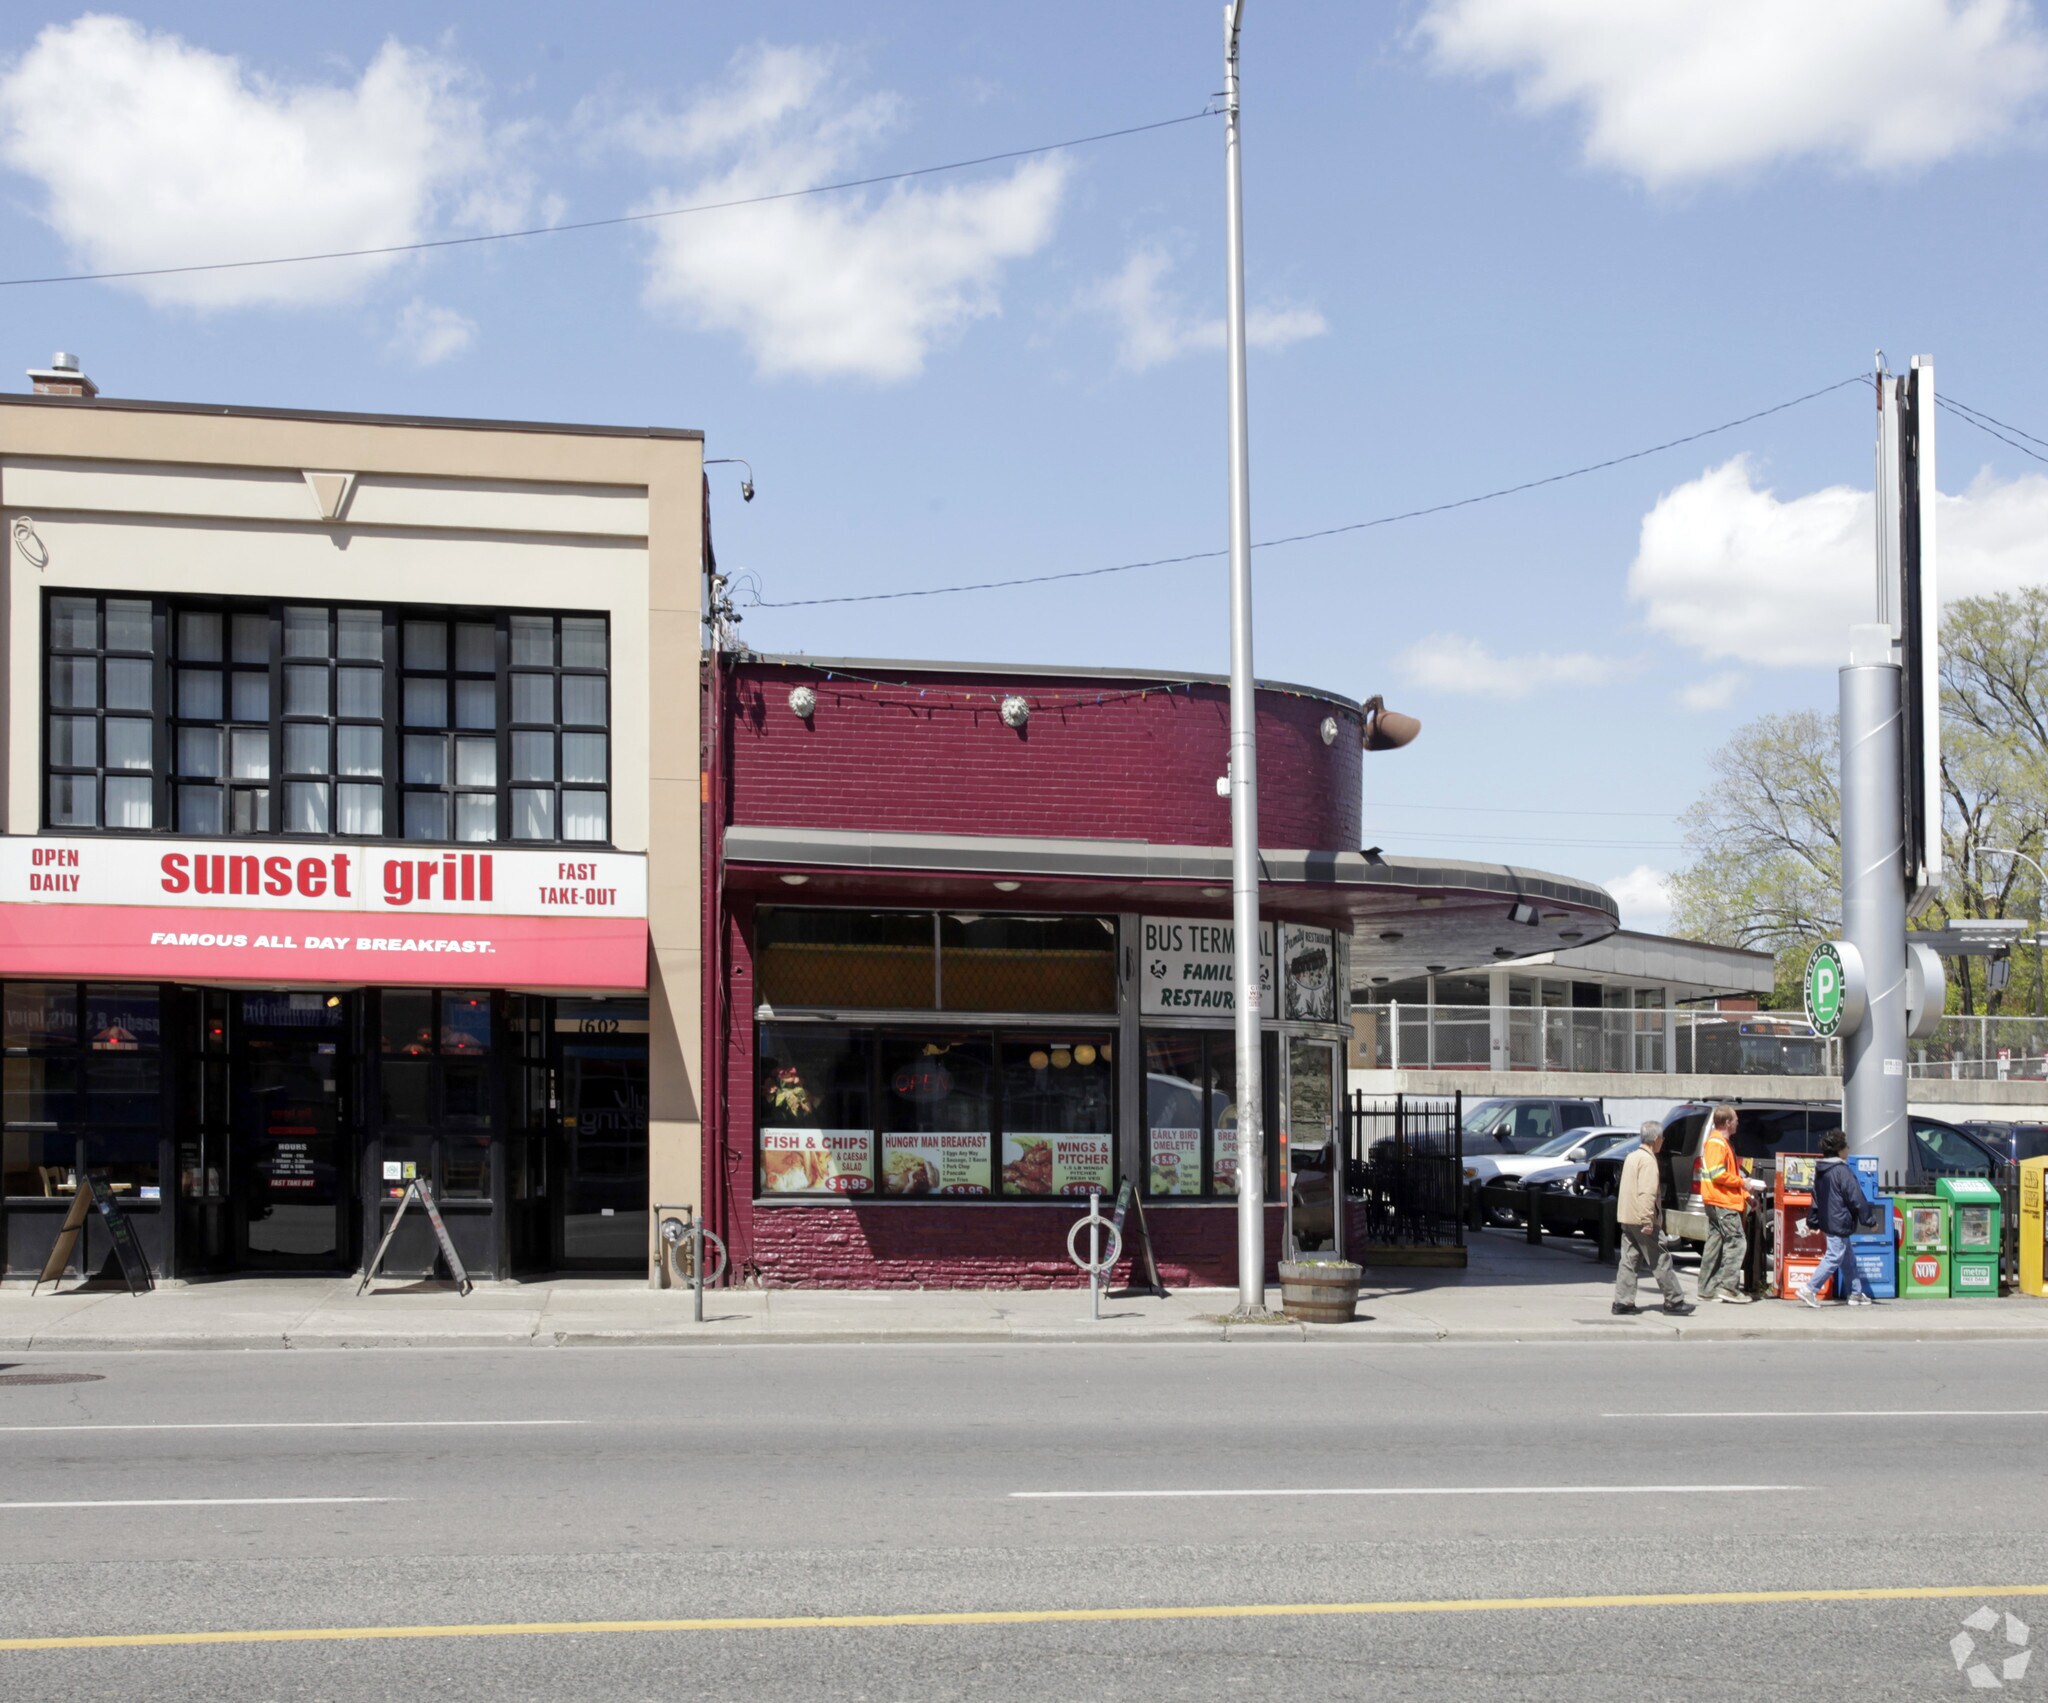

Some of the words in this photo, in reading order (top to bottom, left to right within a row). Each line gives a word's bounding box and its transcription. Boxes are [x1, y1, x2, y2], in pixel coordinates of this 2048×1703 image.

[31, 848, 79, 867] OPEN
[558, 863, 597, 881] FAST
[30, 873, 80, 892] DAILY
[160, 852, 352, 898] sunset
[383, 853, 493, 906] grill
[539, 887, 617, 906] TAKE-OUT
[150, 932, 248, 948] FAMOUS
[253, 934, 298, 949] ALL
[304, 936, 350, 950] DAY
[1146, 924, 1183, 952] BUS
[1183, 963, 1236, 981] FAMIL
[1805, 944, 1845, 989] MUNICIPAL
[1817, 968, 1835, 1005] P
[1161, 988, 1236, 1010] RESTAUR
[1806, 997, 1845, 1034] PARKING
[579, 1019, 620, 1034] 1602
[885, 1135, 919, 1148] HUNGRY
[921, 1136, 939, 1148] MAN
[941, 1136, 987, 1148] BREAKFAST
[1152, 1130, 1177, 1140] EARLY
[1180, 1130, 1199, 1140] BIRD
[278, 1143, 307, 1151] HOURS
[764, 1136, 800, 1149] FISH
[805, 1136, 816, 1149] &
[822, 1136, 869, 1150] CHIPS
[1057, 1142, 1097, 1153] WINGS
[1100, 1142, 1109, 1153] &
[1153, 1141, 1196, 1151] OMELETTE
[836, 1152, 842, 1161] &
[843, 1152, 868, 1161] CAESAR
[1058, 1154, 1108, 1164] PITCHER
[1154, 1155, 1160, 1164] $
[1161, 1155, 1178, 1164] 5.95
[842, 1162, 862, 1171] SALAD
[1218, 1161, 1224, 1169] $
[271, 1179, 286, 1187] FAST
[302, 1179, 315, 1187] OUT
[828, 1178, 837, 1190] $
[840, 1178, 867, 1190] 9.95
[946, 1186, 955, 1194] $
[957, 1186, 984, 1194] 9.95
[1063, 1185, 1070, 1195] $
[1073, 1185, 1102, 1195] 19.95
[1915, 1262, 1938, 1278] NOW
[1963, 1267, 1987, 1276] metro
